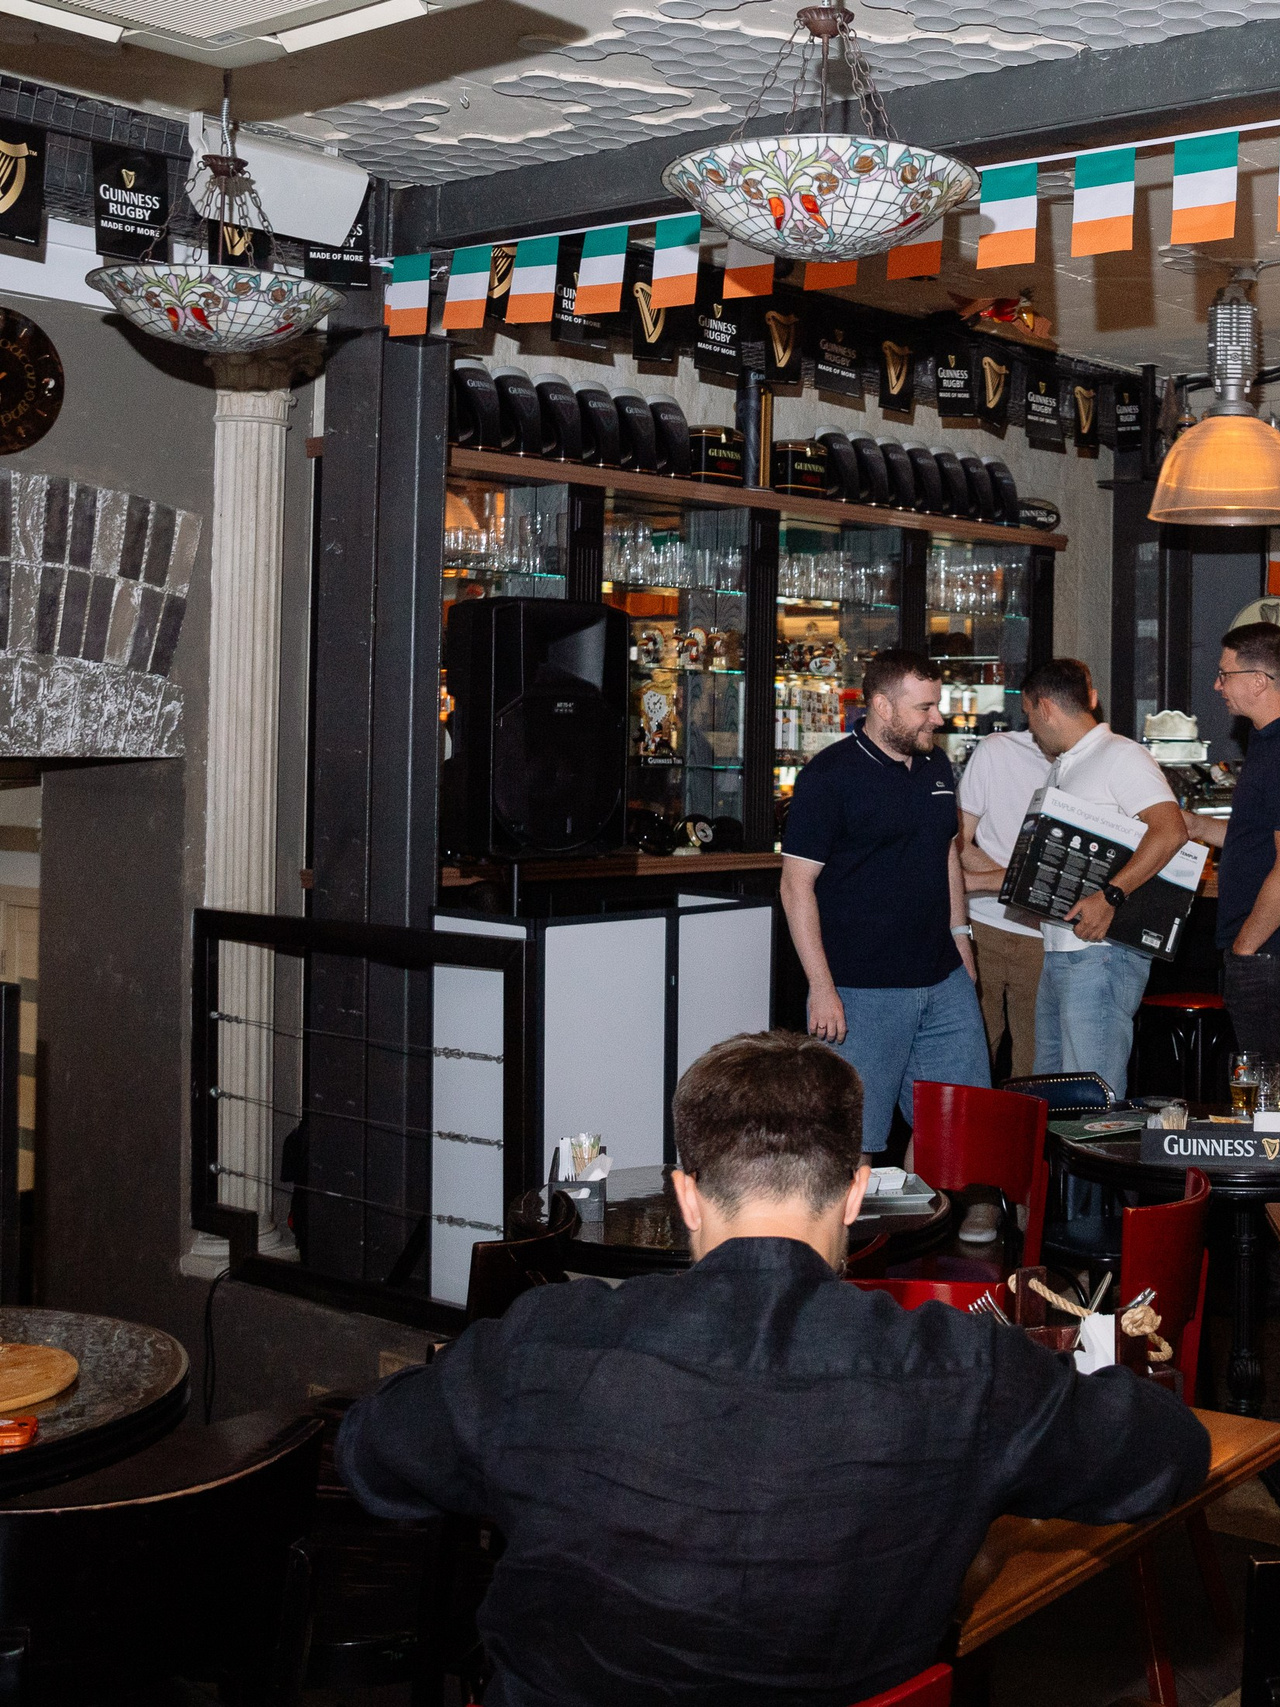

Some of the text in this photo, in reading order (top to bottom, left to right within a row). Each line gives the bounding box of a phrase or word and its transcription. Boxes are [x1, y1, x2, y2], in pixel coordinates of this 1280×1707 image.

[99, 183, 161, 209] GUINNESS
[108, 202, 152, 221] RUGBY
[100, 219, 161, 238] MADE OF MORE
[309, 251, 331, 260] MADE
[343, 254, 364, 262] MORE
[573, 315, 583, 324] OF
[698, 314, 738, 335] GUINNESS
[703, 328, 732, 344] RUGBY
[697, 341, 736, 357] MADE OF MORE
[819, 338, 857, 359] GUINNESS
[823, 352, 852, 367] RUGBY
[817, 363, 857, 379] MADE OF MORE
[937, 366, 969, 380] GUINNESS
[942, 379, 965, 389] RUGBY
[1027, 391, 1057, 408] GUINNESS
[1031, 403, 1054, 415] RUGBY
[1115, 404, 1140, 415] GUINNESS
[1119, 413, 1137, 423] RUGBY
[707, 447, 742, 461] GUINNESS
[794, 461, 826, 474] GUINNESS
[647, 756, 673, 765] GUINNESS
[1051, 798, 1077, 812] TEMPUR
[1076, 808, 1100, 823] Original
[1179, 850, 1198, 860] TEMPUR
[1163, 1134, 1255, 1157] GUINNESS
